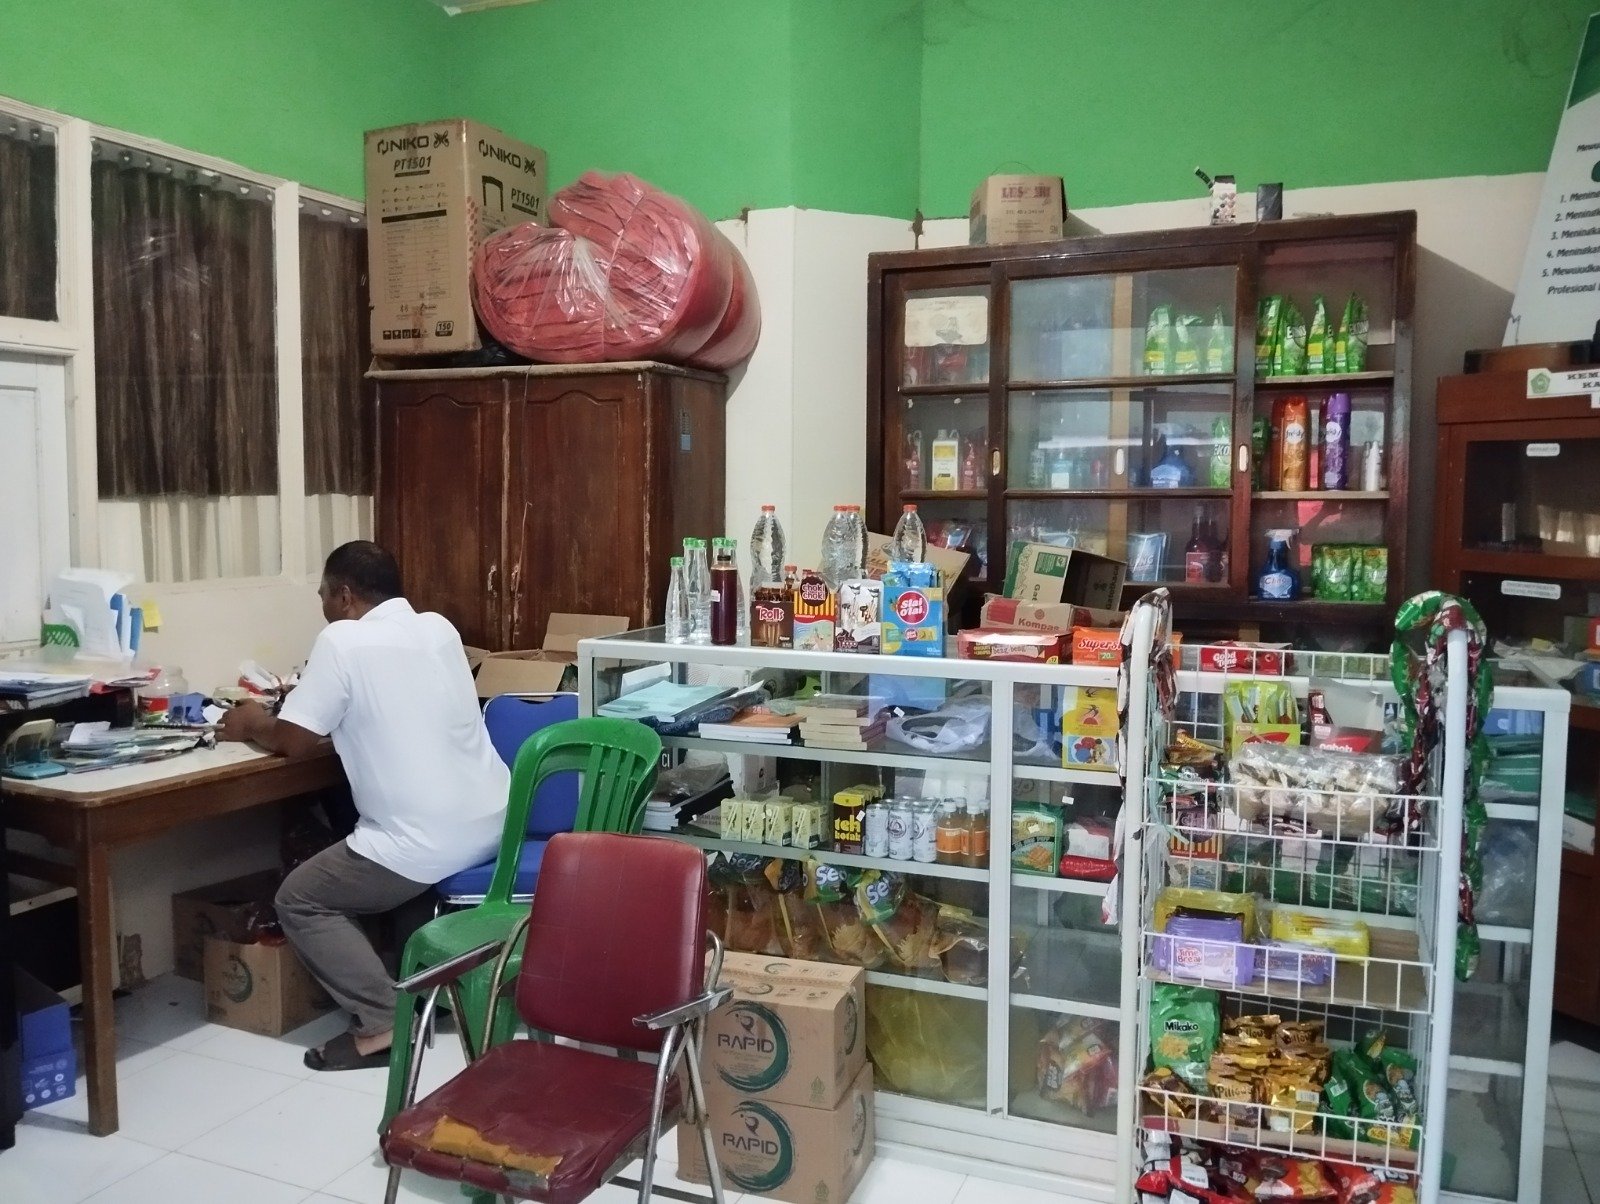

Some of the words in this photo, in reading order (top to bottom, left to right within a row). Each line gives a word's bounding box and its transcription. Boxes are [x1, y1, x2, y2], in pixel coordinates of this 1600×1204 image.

[394, 156, 432, 171] PT1501
[511, 188, 540, 209] PT1501
[1555, 213, 1562, 222] 2.
[1542, 268, 1549, 277] 5.
[834, 814, 861, 832] teh
[1177, 955, 1203, 964] Brea
[1164, 1021, 1200, 1033] Mikako
[717, 1033, 775, 1053] RAPID
[722, 1133, 778, 1155] RAPID
